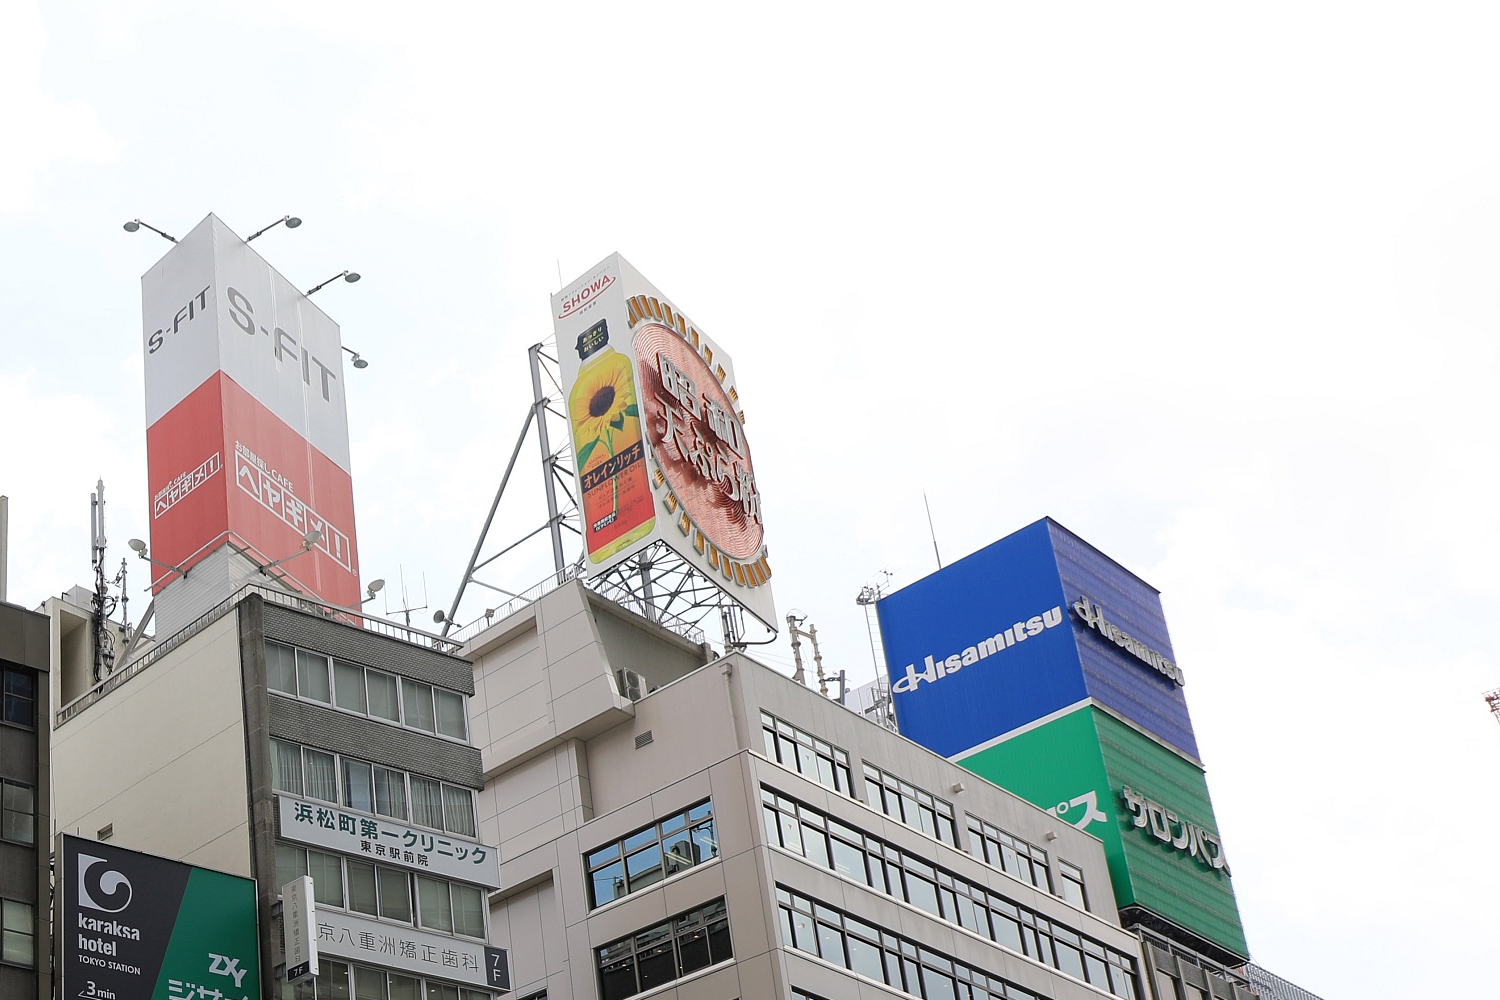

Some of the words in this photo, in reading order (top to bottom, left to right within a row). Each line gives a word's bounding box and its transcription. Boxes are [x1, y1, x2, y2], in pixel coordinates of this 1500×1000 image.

[562, 274, 611, 313] SHOWA
[147, 284, 211, 355] S-FIT
[226, 284, 337, 404] S-FIT
[174, 471, 187, 487] CAFE
[235, 440, 271, 475] お部屋探し
[271, 467, 294, 492] CAFE
[583, 445, 641, 490] オレインリッチ
[892, 604, 1063, 694] Hisamitsu
[1073, 595, 1186, 688] Hisamitsu
[294, 802, 487, 865] 浜松町第一クリニック
[1122, 784, 1231, 878] サロンパス
[360, 839, 429, 867] 東京駅前院
[78, 912, 140, 941] karaksa
[78, 933, 117, 956] hotel
[78, 954, 106, 968] TOKYO
[108, 960, 141, 975] STATION
[491, 953, 501, 982] 7F
[86, 980, 96, 996] 3
[97, 987, 116, 1000] min
